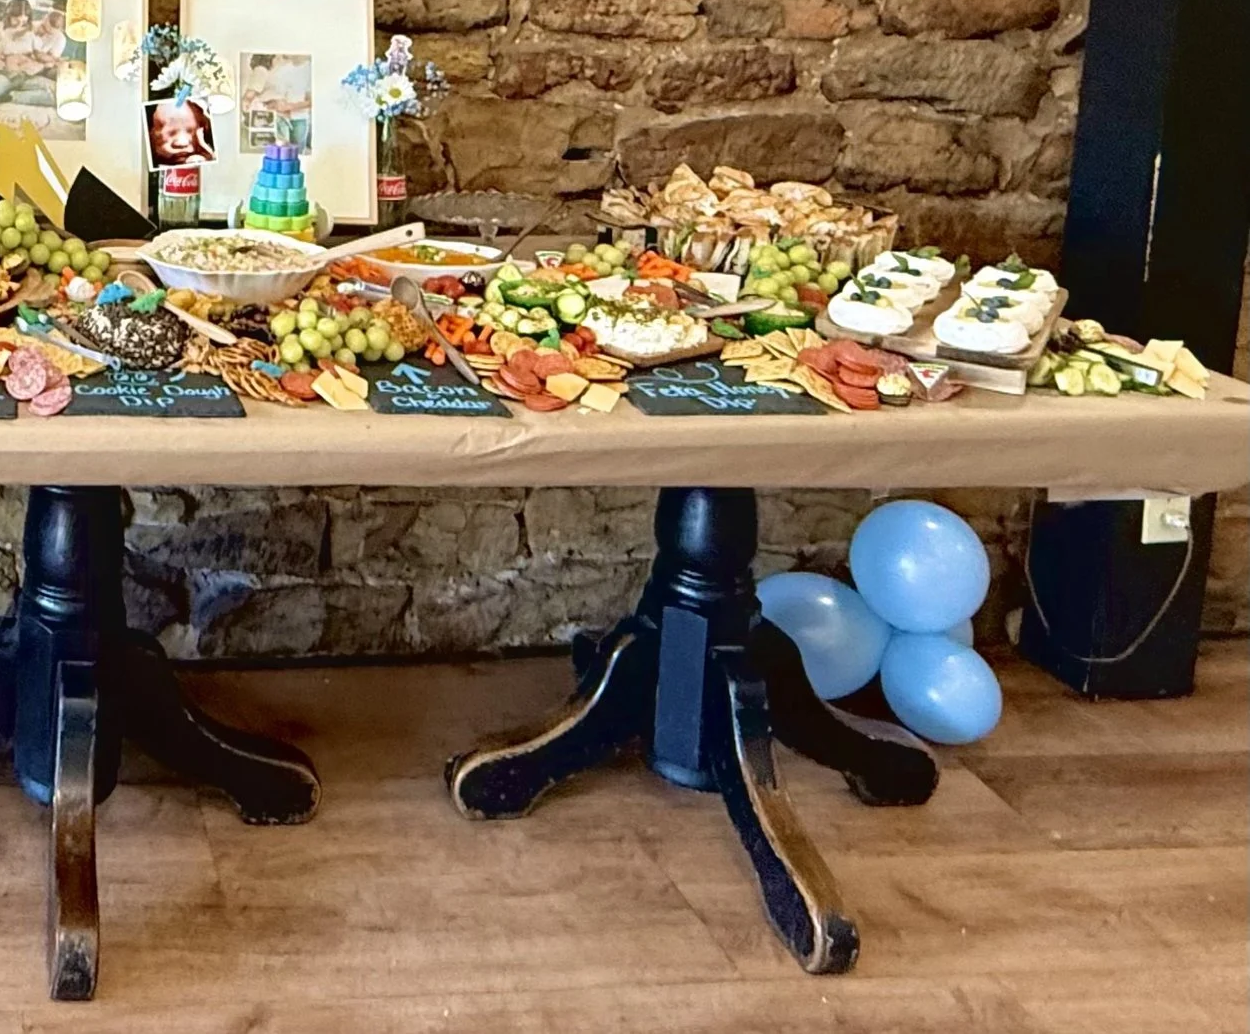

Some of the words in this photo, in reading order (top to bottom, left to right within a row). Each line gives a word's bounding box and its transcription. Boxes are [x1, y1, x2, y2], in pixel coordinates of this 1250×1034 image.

[74, 383, 150, 396] Cookie
[162, 384, 231, 400] Dough
[375, 380, 478, 398] Bacon
[633, 382, 707, 398] Feta
[705, 381, 790, 399] Honey
[118, 395, 175, 408] Dip
[391, 396, 492, 410] Cheddar
